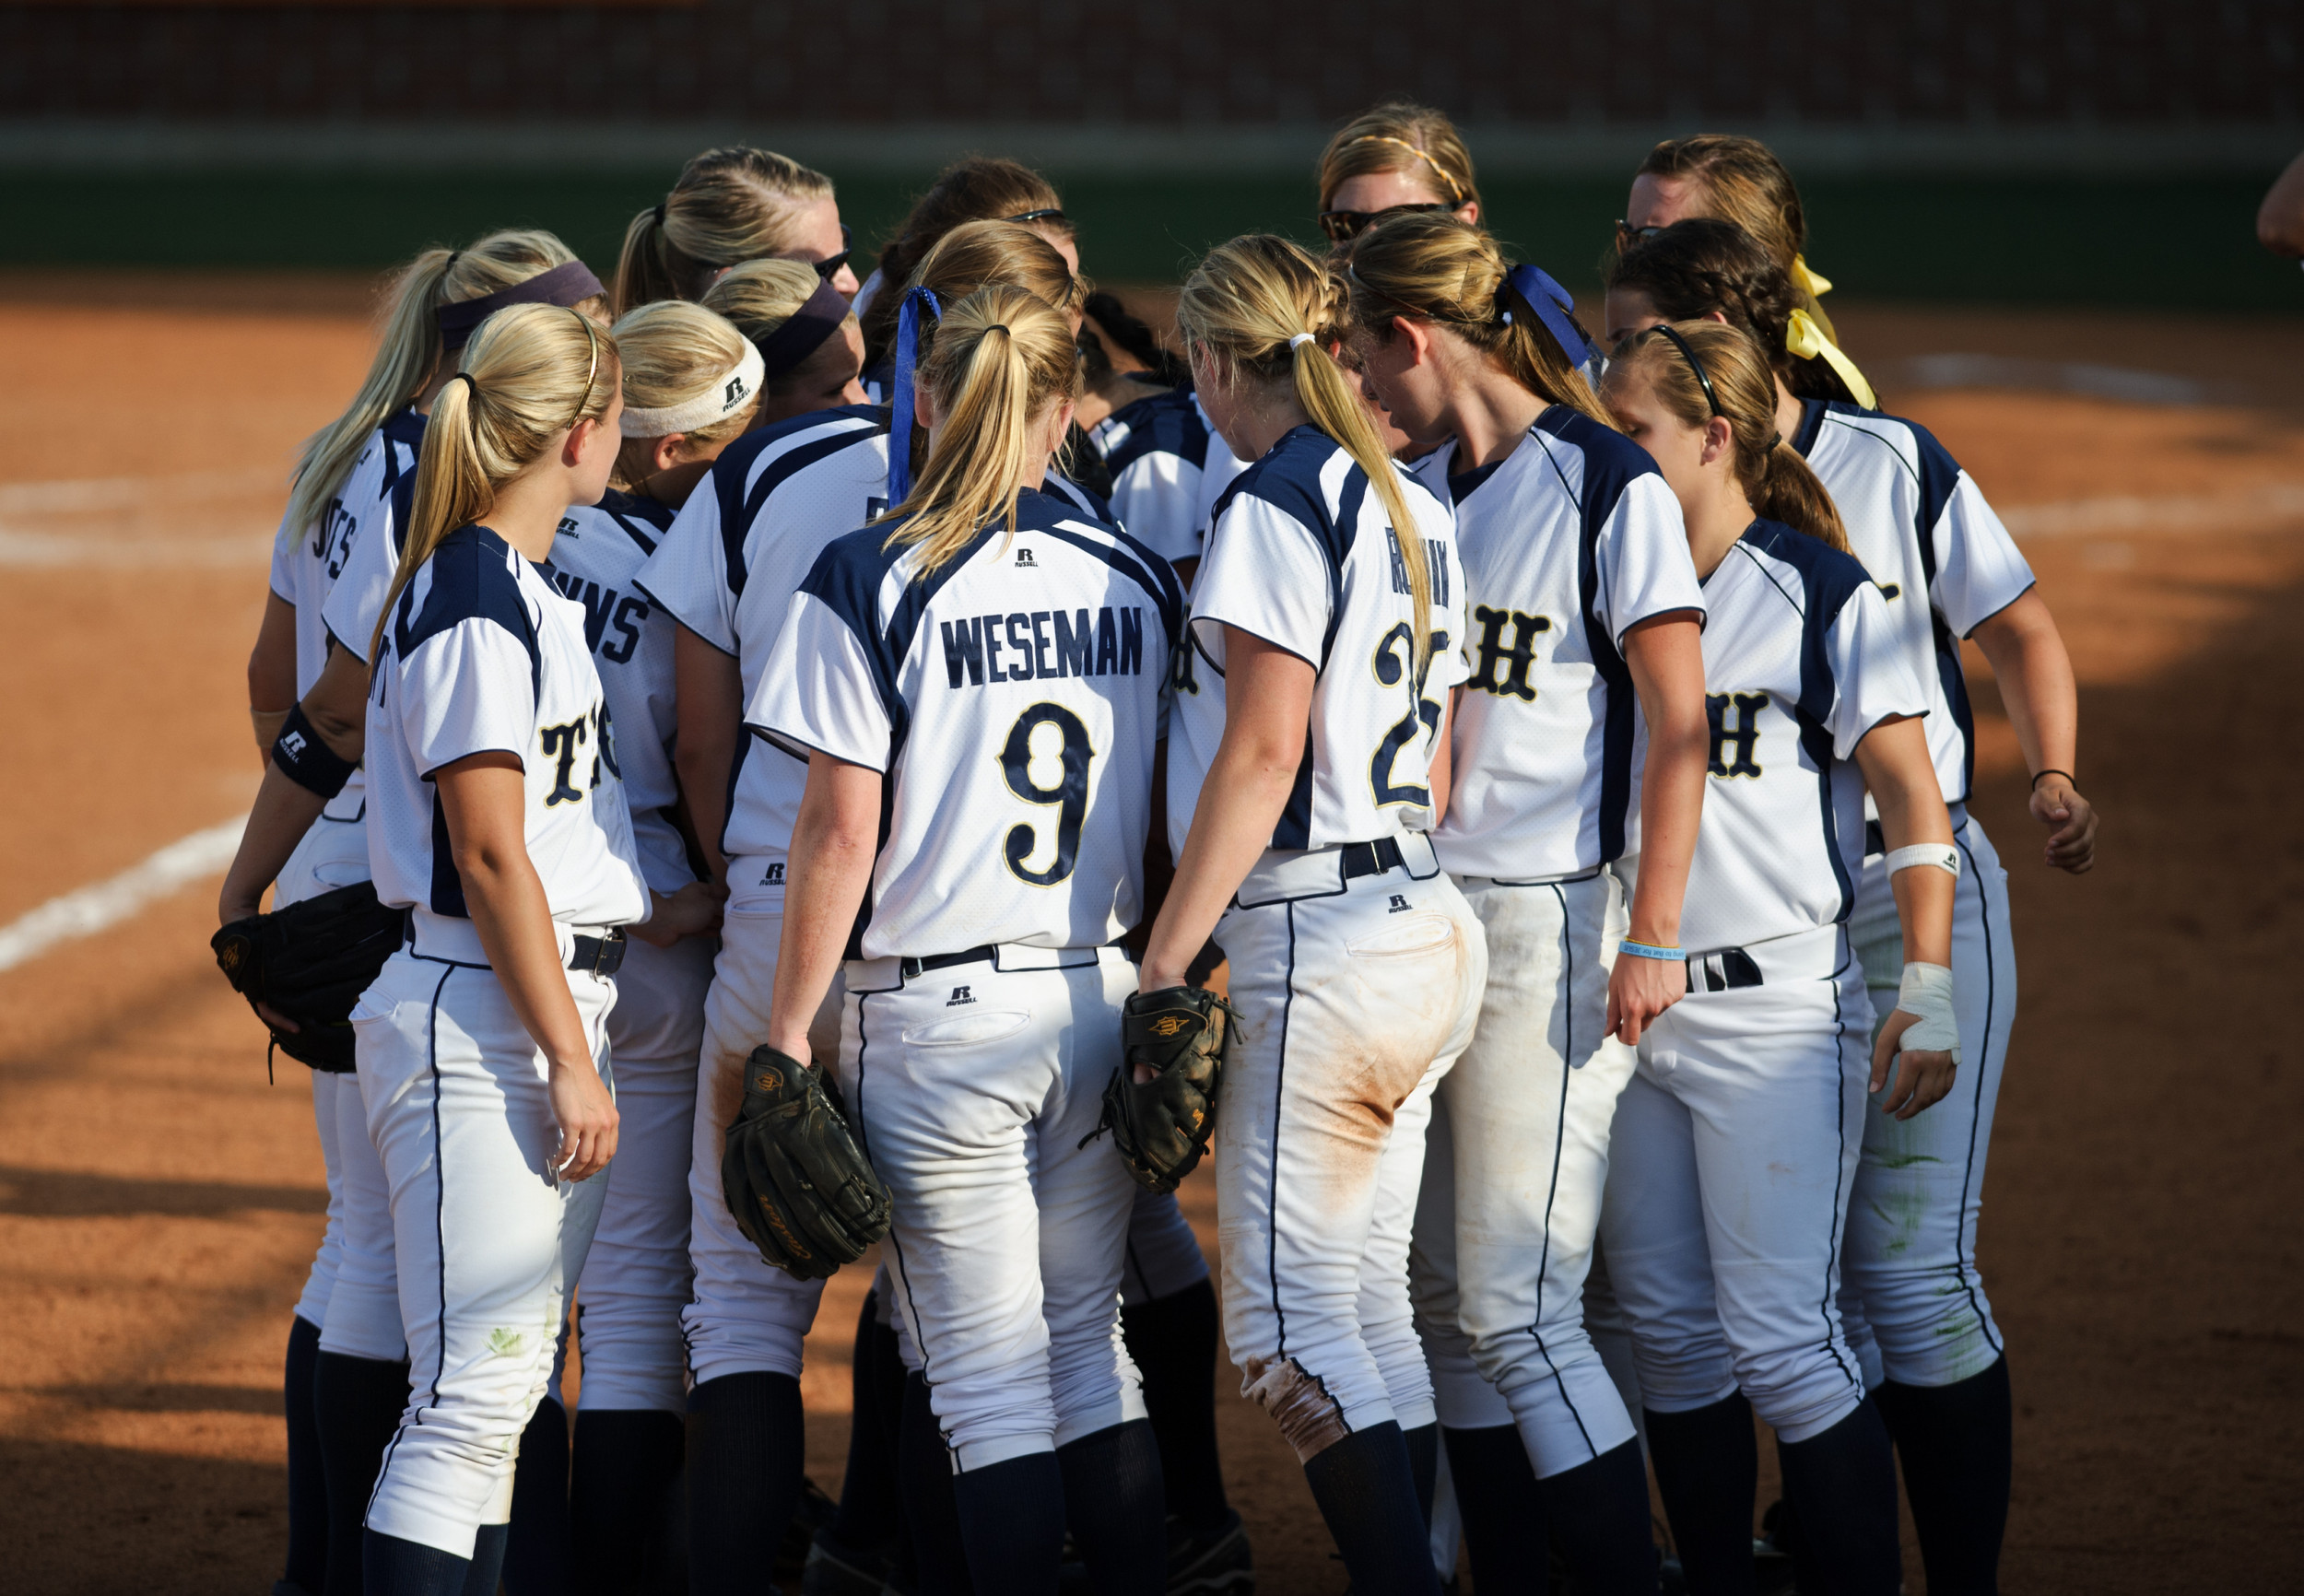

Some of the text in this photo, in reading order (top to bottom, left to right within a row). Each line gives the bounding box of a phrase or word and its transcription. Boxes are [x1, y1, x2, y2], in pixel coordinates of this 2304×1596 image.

[940, 606, 1143, 689] WESEMAN
[994, 699, 1097, 889] 9
[1623, 945, 1640, 954] JESUS
